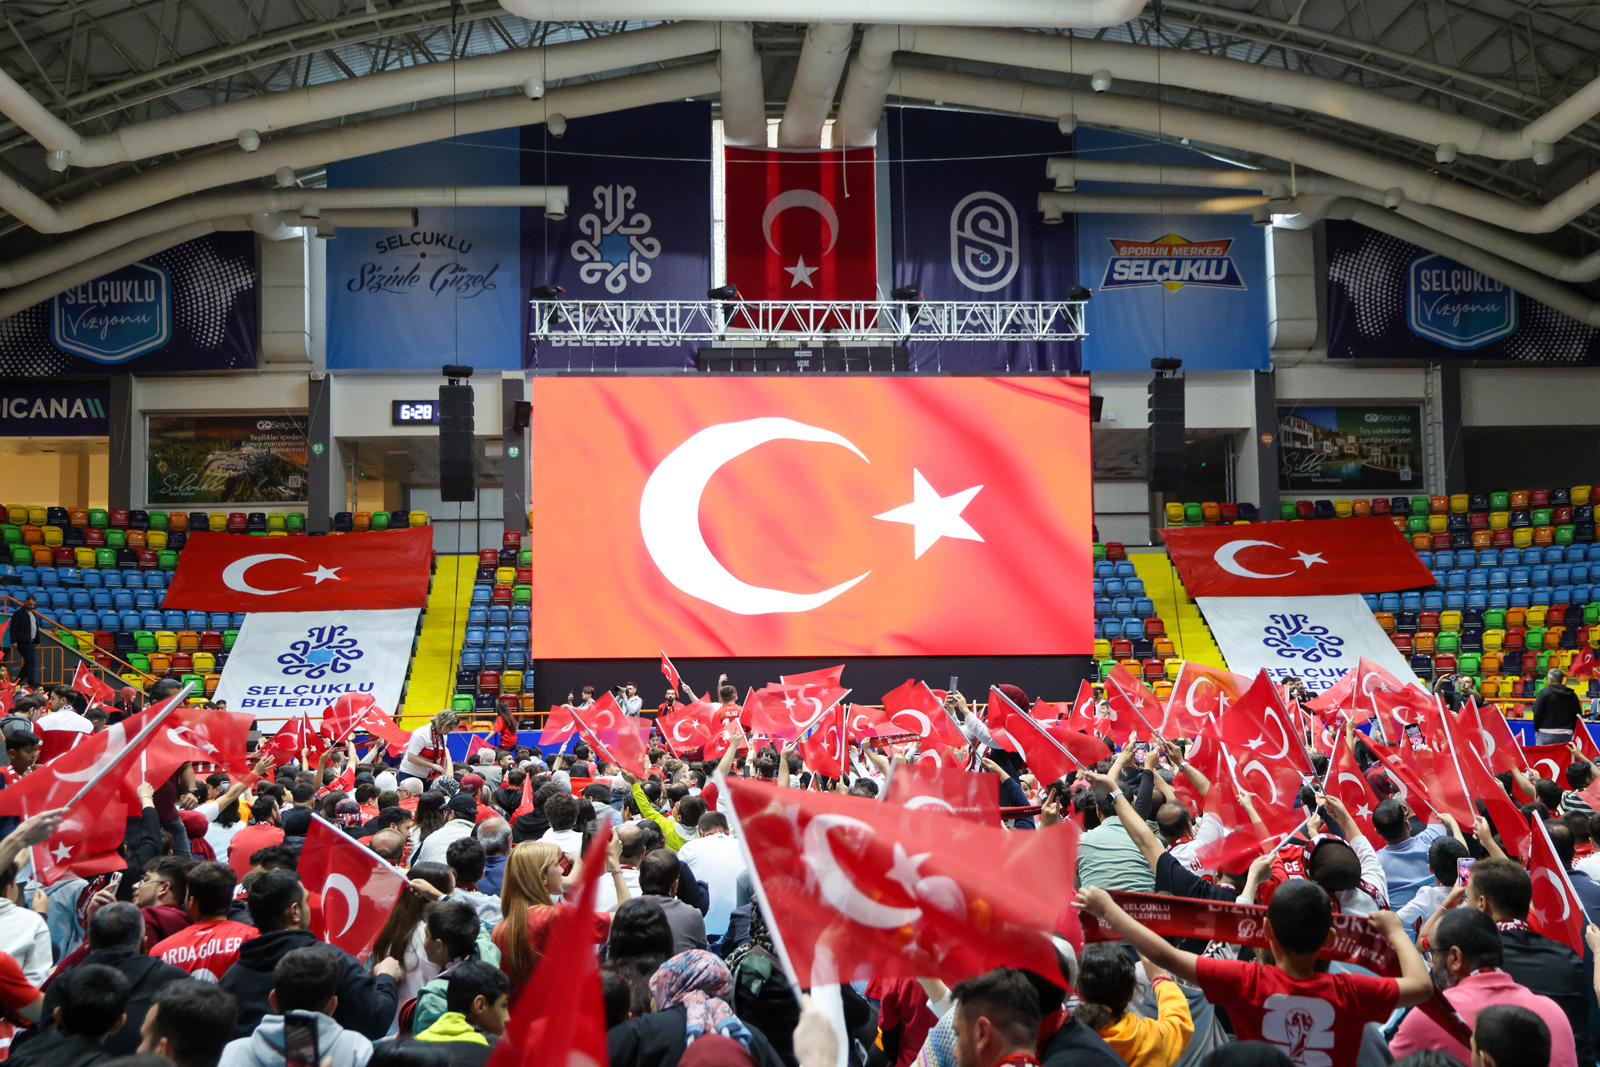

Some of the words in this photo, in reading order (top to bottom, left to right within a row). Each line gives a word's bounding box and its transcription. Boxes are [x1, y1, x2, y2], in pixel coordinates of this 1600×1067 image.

[376, 231, 473, 254] SELÇUKLU
[1119, 247, 1168, 256] SPORUN
[1113, 259, 1229, 283] SELÇUKLU
[429, 262, 500, 299] Güzel
[0, 398, 88, 418] ICANA
[401, 404, 432, 419] 6:28
[509, 447, 518, 455] D2
[1266, 667, 1355, 680] SELÇUK
[246, 682, 374, 697] SELÇUKLU
[241, 696, 340, 708] BELEDİY
[1122, 903, 1171, 913] SELÇUKLU
[1130, 911, 1171, 921] ELEDİYESİ
[162, 945, 197, 965] ARDA
[199, 937, 243, 959] GÜLER
